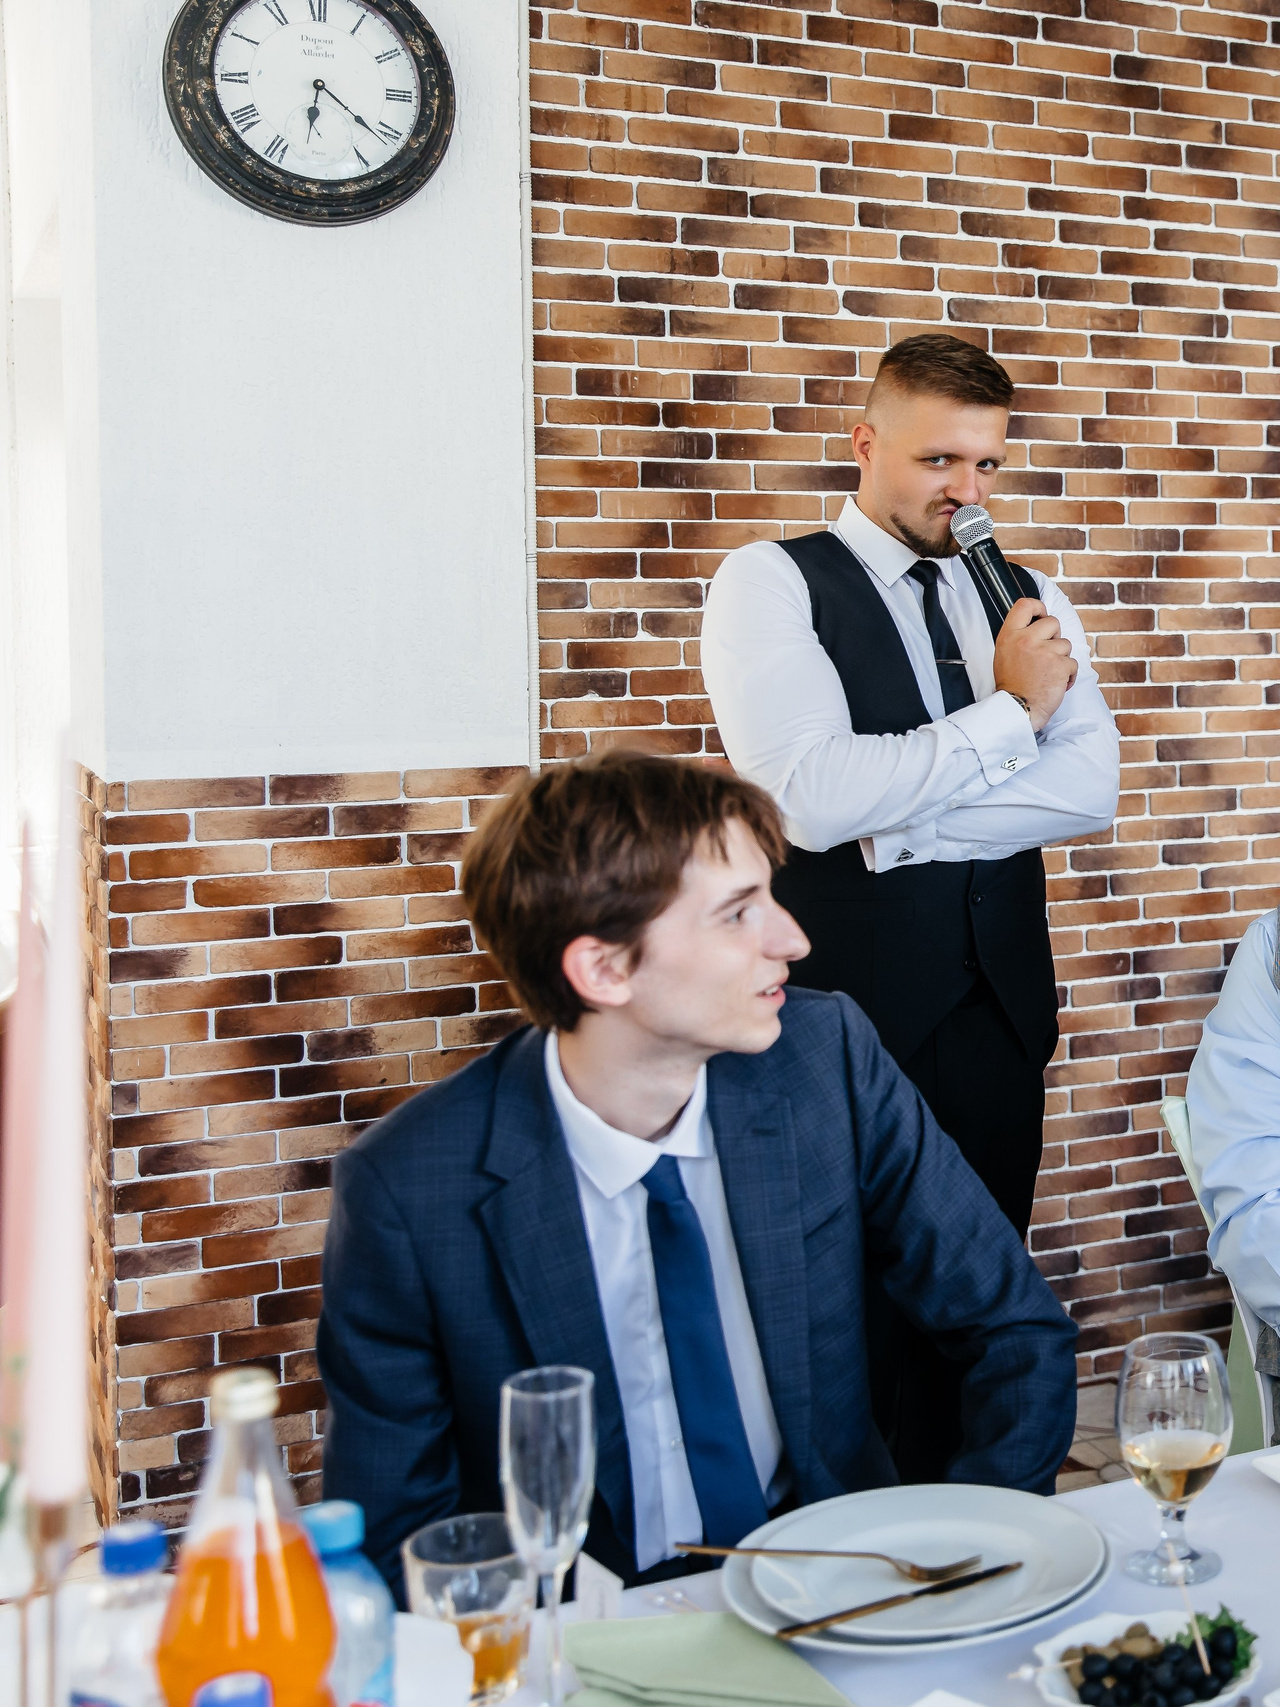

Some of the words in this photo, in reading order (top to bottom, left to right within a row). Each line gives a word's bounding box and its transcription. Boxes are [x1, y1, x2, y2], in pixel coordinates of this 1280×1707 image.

[304, 0, 328, 23] XII
[301, 34, 334, 45] Dupont
[385, 88, 413, 104] III
